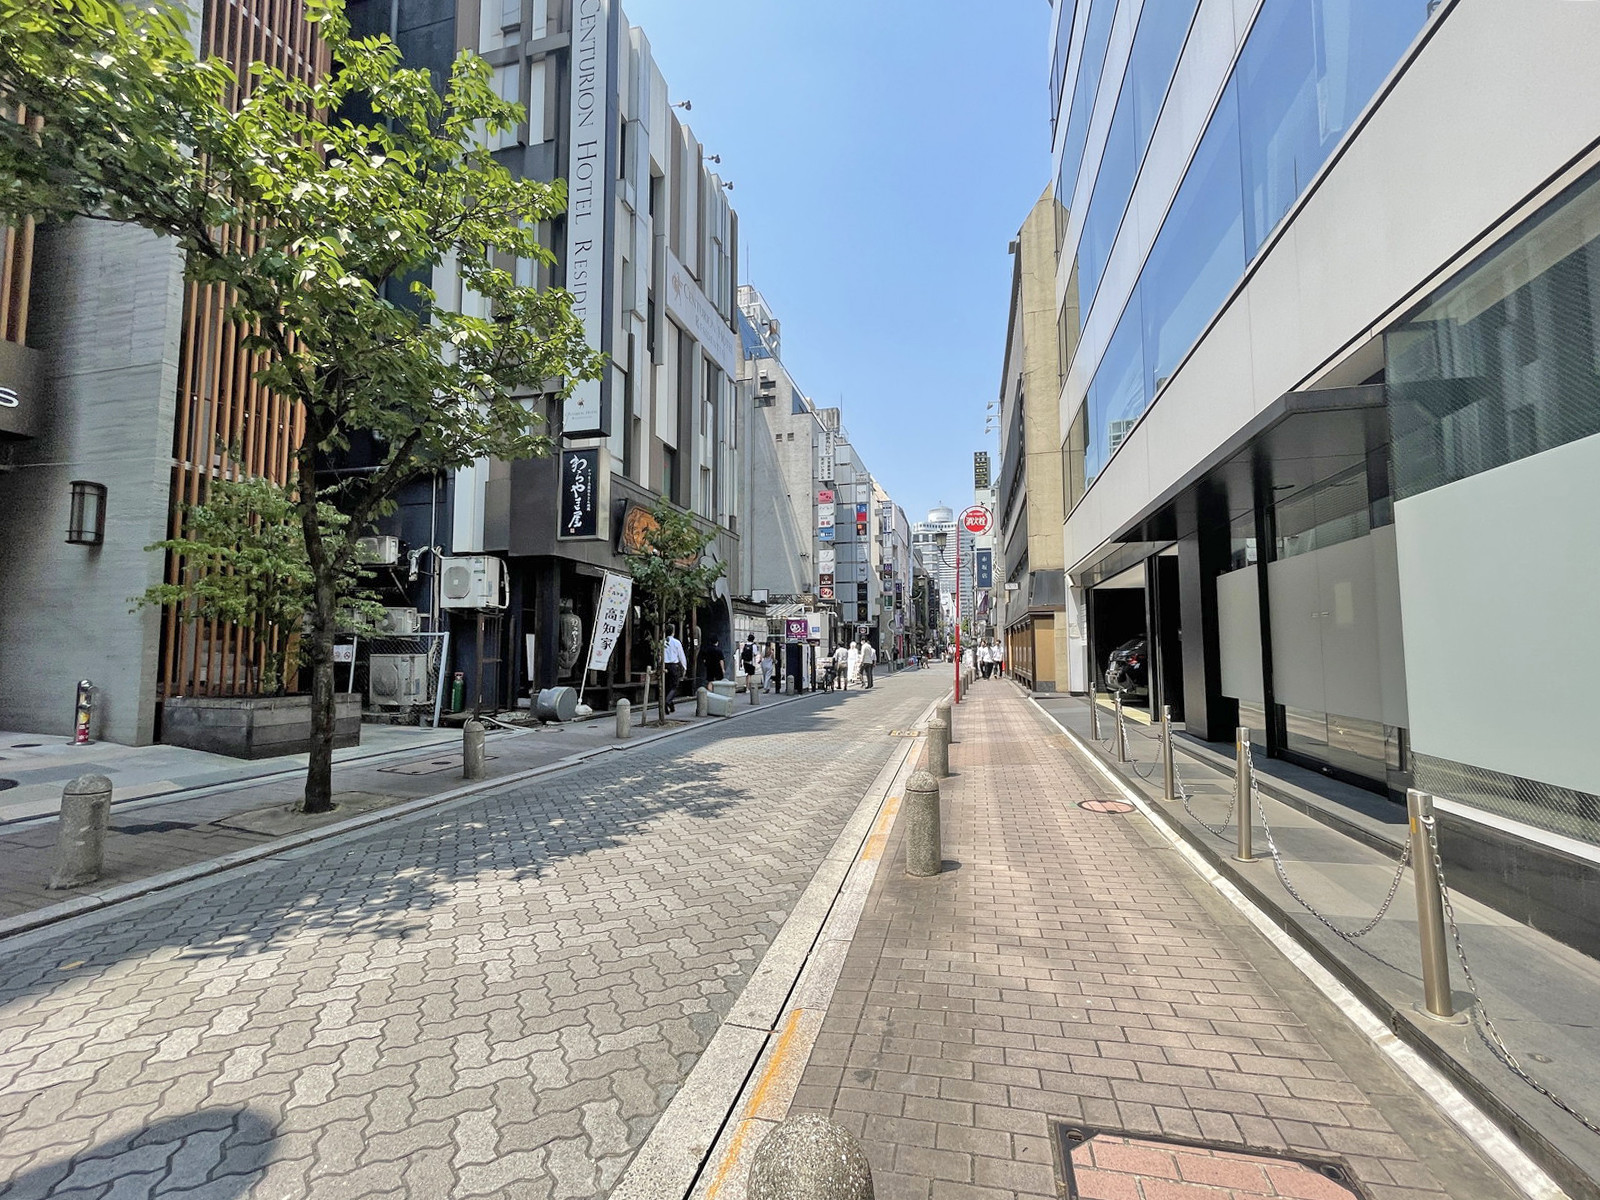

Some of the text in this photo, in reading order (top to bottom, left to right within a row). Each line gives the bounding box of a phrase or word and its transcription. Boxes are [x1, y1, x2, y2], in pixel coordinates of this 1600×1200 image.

[578, 0, 600, 127] CENTURION
[576, 140, 597, 225] HOTEL
[568, 454, 588, 528] わらやき屋
[965, 516, 986, 526] 消火栓
